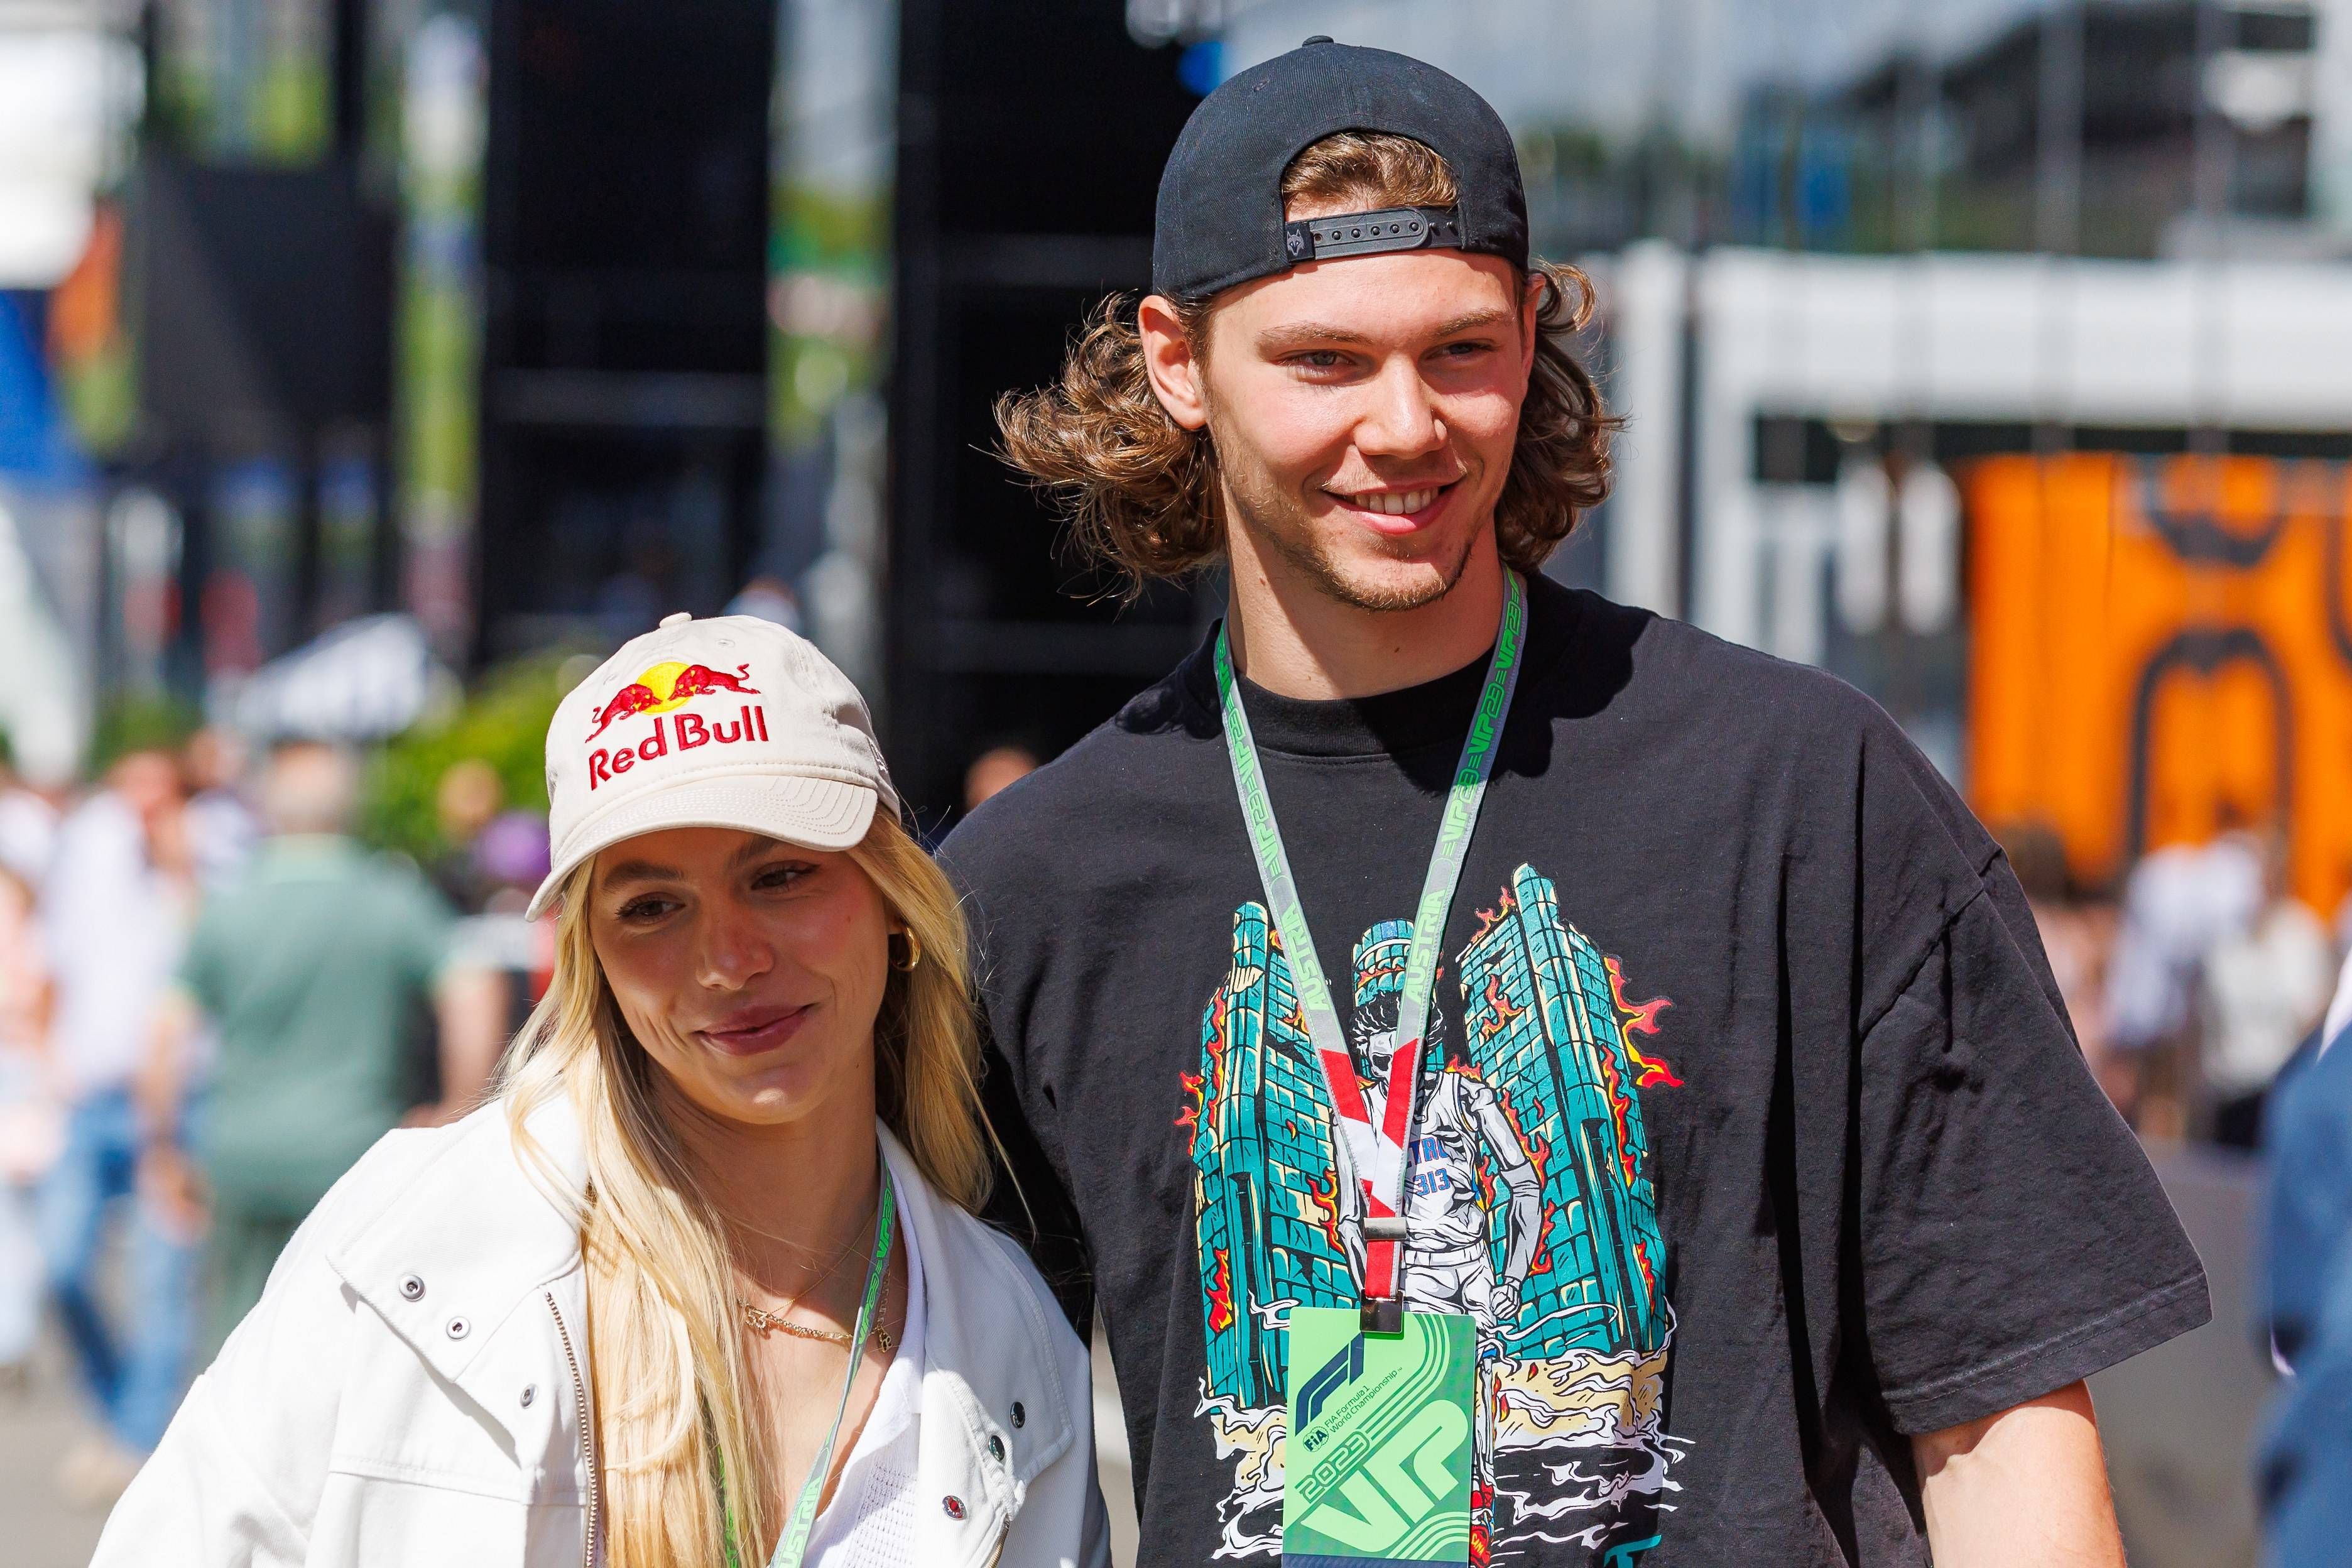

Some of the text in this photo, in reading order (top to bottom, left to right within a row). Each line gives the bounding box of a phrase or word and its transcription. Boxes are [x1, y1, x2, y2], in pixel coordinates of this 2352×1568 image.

[588, 705, 769, 791] Red Bull
[1282, 903, 1330, 1010] AUSTRIA
[1406, 888, 1446, 1003] AUSTRIA
[1412, 1168, 1451, 1196] 313
[1324, 1415, 1338, 1427] FIA
[1336, 1389, 1366, 1417] Formula
[1329, 1412, 1352, 1432] World
[1294, 1430, 1371, 1504] 2023
[1300, 1399, 1469, 1552] VIP
[778, 1477, 822, 1568] USTRIA
